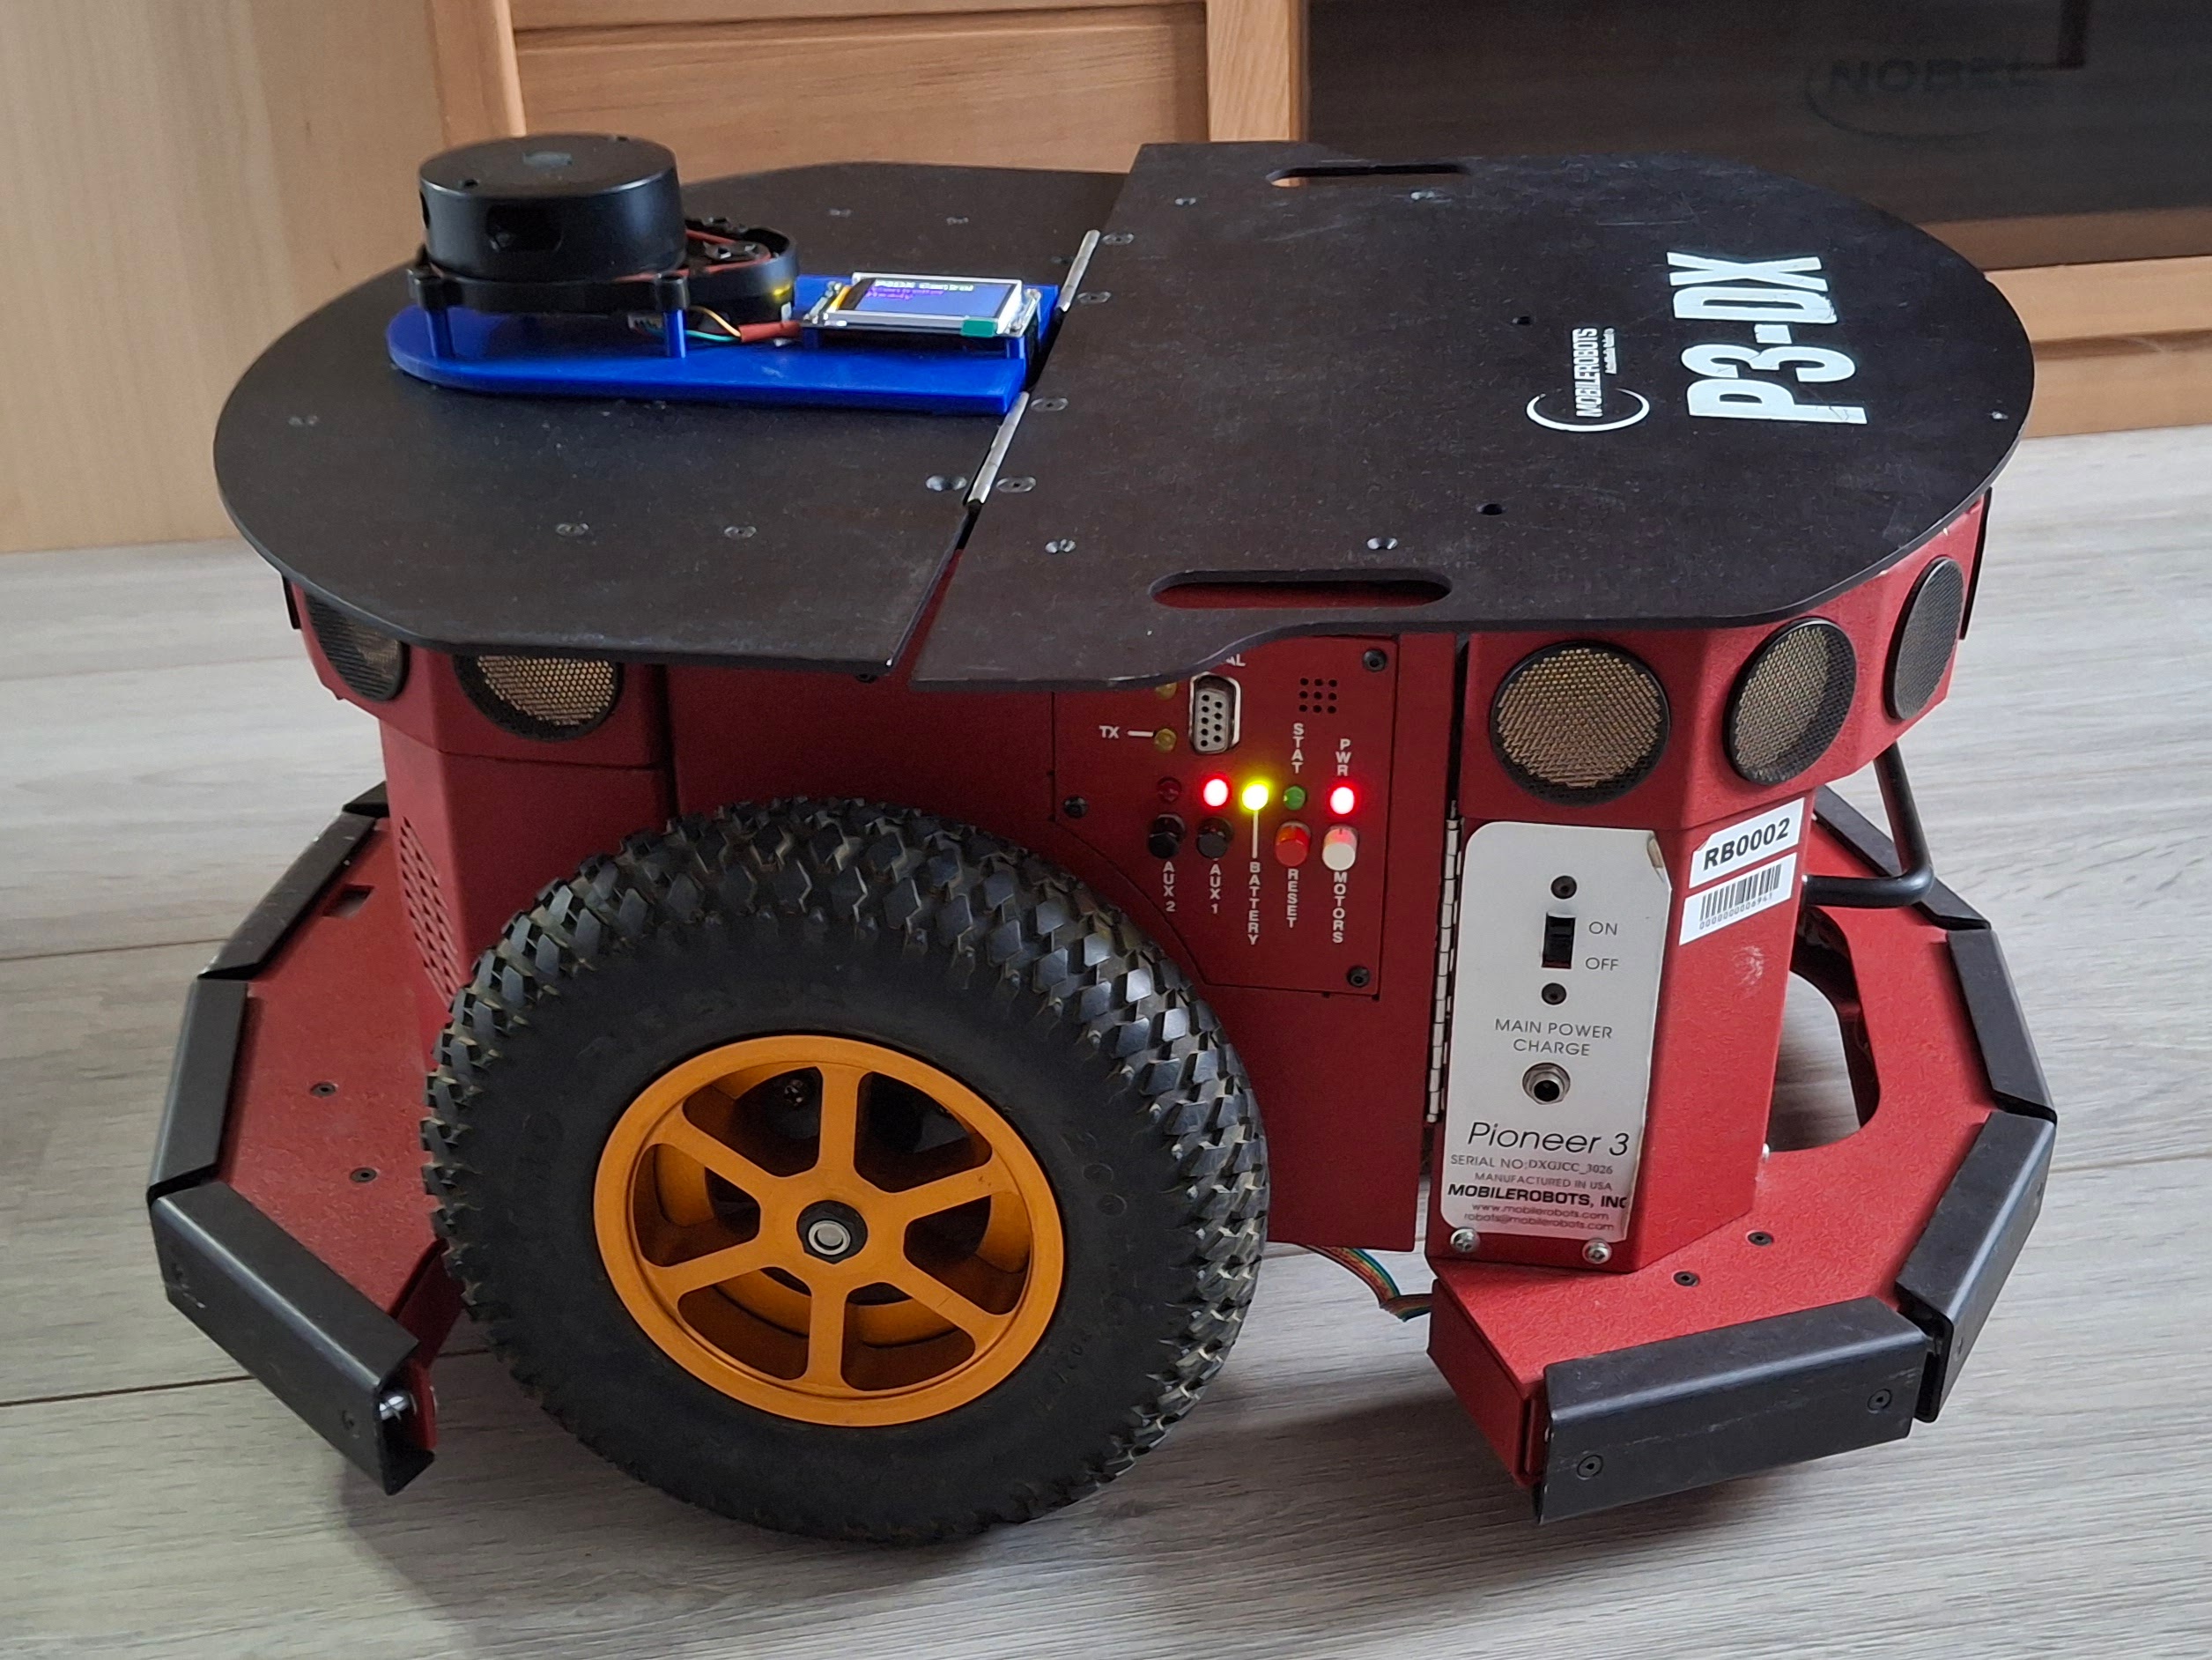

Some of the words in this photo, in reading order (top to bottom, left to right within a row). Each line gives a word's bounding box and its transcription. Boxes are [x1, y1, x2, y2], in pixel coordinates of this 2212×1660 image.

[1666, 251, 1868, 425] P3-DX
[1571, 328, 1603, 418] MOBILEROBOTS
[1099, 725, 1120, 739] TX
[1291, 723, 1305, 774] STAT
[1335, 738, 1352, 776] PWR
[1703, 818, 1790, 871] RB0002
[1163, 861, 1175, 897] AUX
[1210, 864, 1222, 900] AUX
[1165, 900, 1176, 913] 2
[1211, 903, 1218, 914] 1
[1247, 861, 1261, 946] BATTERY
[1286, 869, 1299, 929] RESET
[1332, 872, 1347, 944] MOTORS
[1588, 921, 1618, 936] ON
[1585, 957, 1619, 971] OFF
[1495, 1018, 1542, 1034] MAIN
[1548, 1022, 1613, 1039] POWER
[1513, 1038, 1591, 1056] CHARGE
[1468, 1122, 1602, 1154] Pioneer
[1609, 1132, 1630, 1156] 3
[1450, 1154, 1495, 1168] SERIAL
[1474, 1172, 1572, 1188] MANUFACTURED
[1574, 1179, 1587, 1189] IN
[1589, 1180, 1613, 1190] USA
[1447, 1184, 1594, 1208] MOBILEROBOTS,
[1472, 1203, 1609, 1221] www.mobilerobots.com
